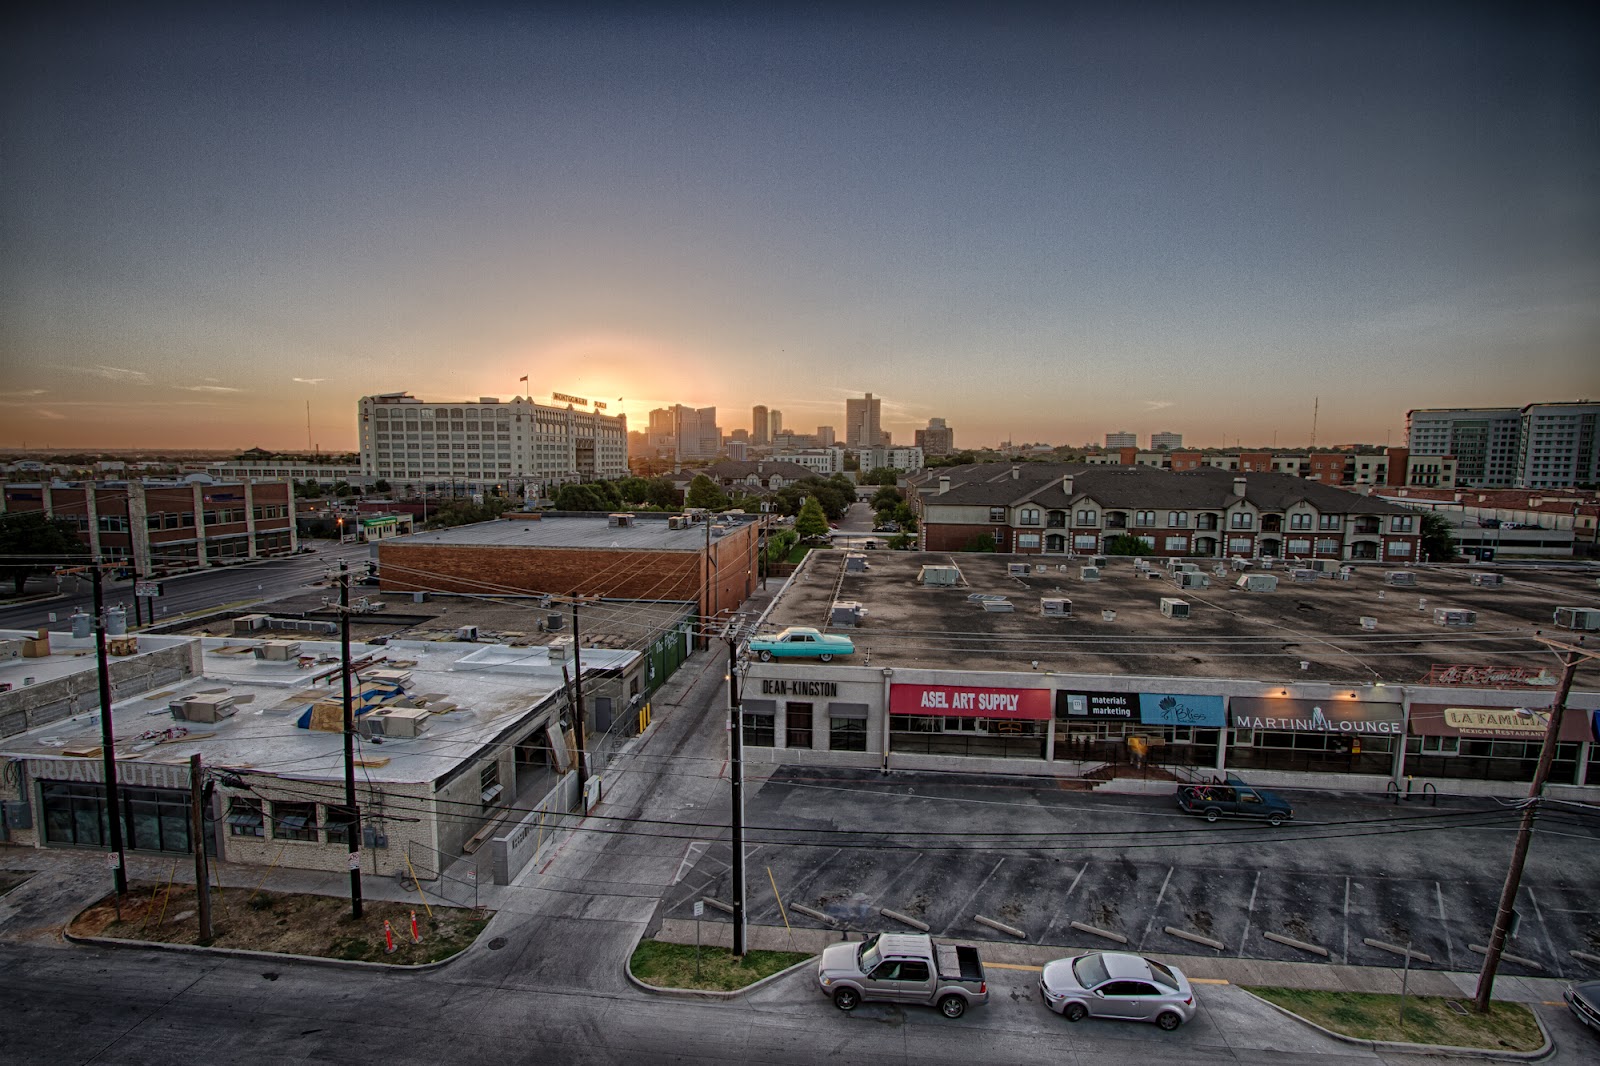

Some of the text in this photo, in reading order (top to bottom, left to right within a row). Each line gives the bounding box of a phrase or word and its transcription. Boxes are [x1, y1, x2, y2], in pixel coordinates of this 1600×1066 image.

[762, 679, 837, 697] DEAN-KINGSTON
[920, 691, 1019, 711] ASEL ART SUPPLY
[1091, 697, 1127, 705] materials
[1092, 706, 1131, 717] marketing
[1175, 704, 1207, 721] Bliss
[1450, 712, 1473, 724] LA
[1237, 715, 1402, 733] MARTINI LOUNGE
[27, 760, 101, 783] URBAN
